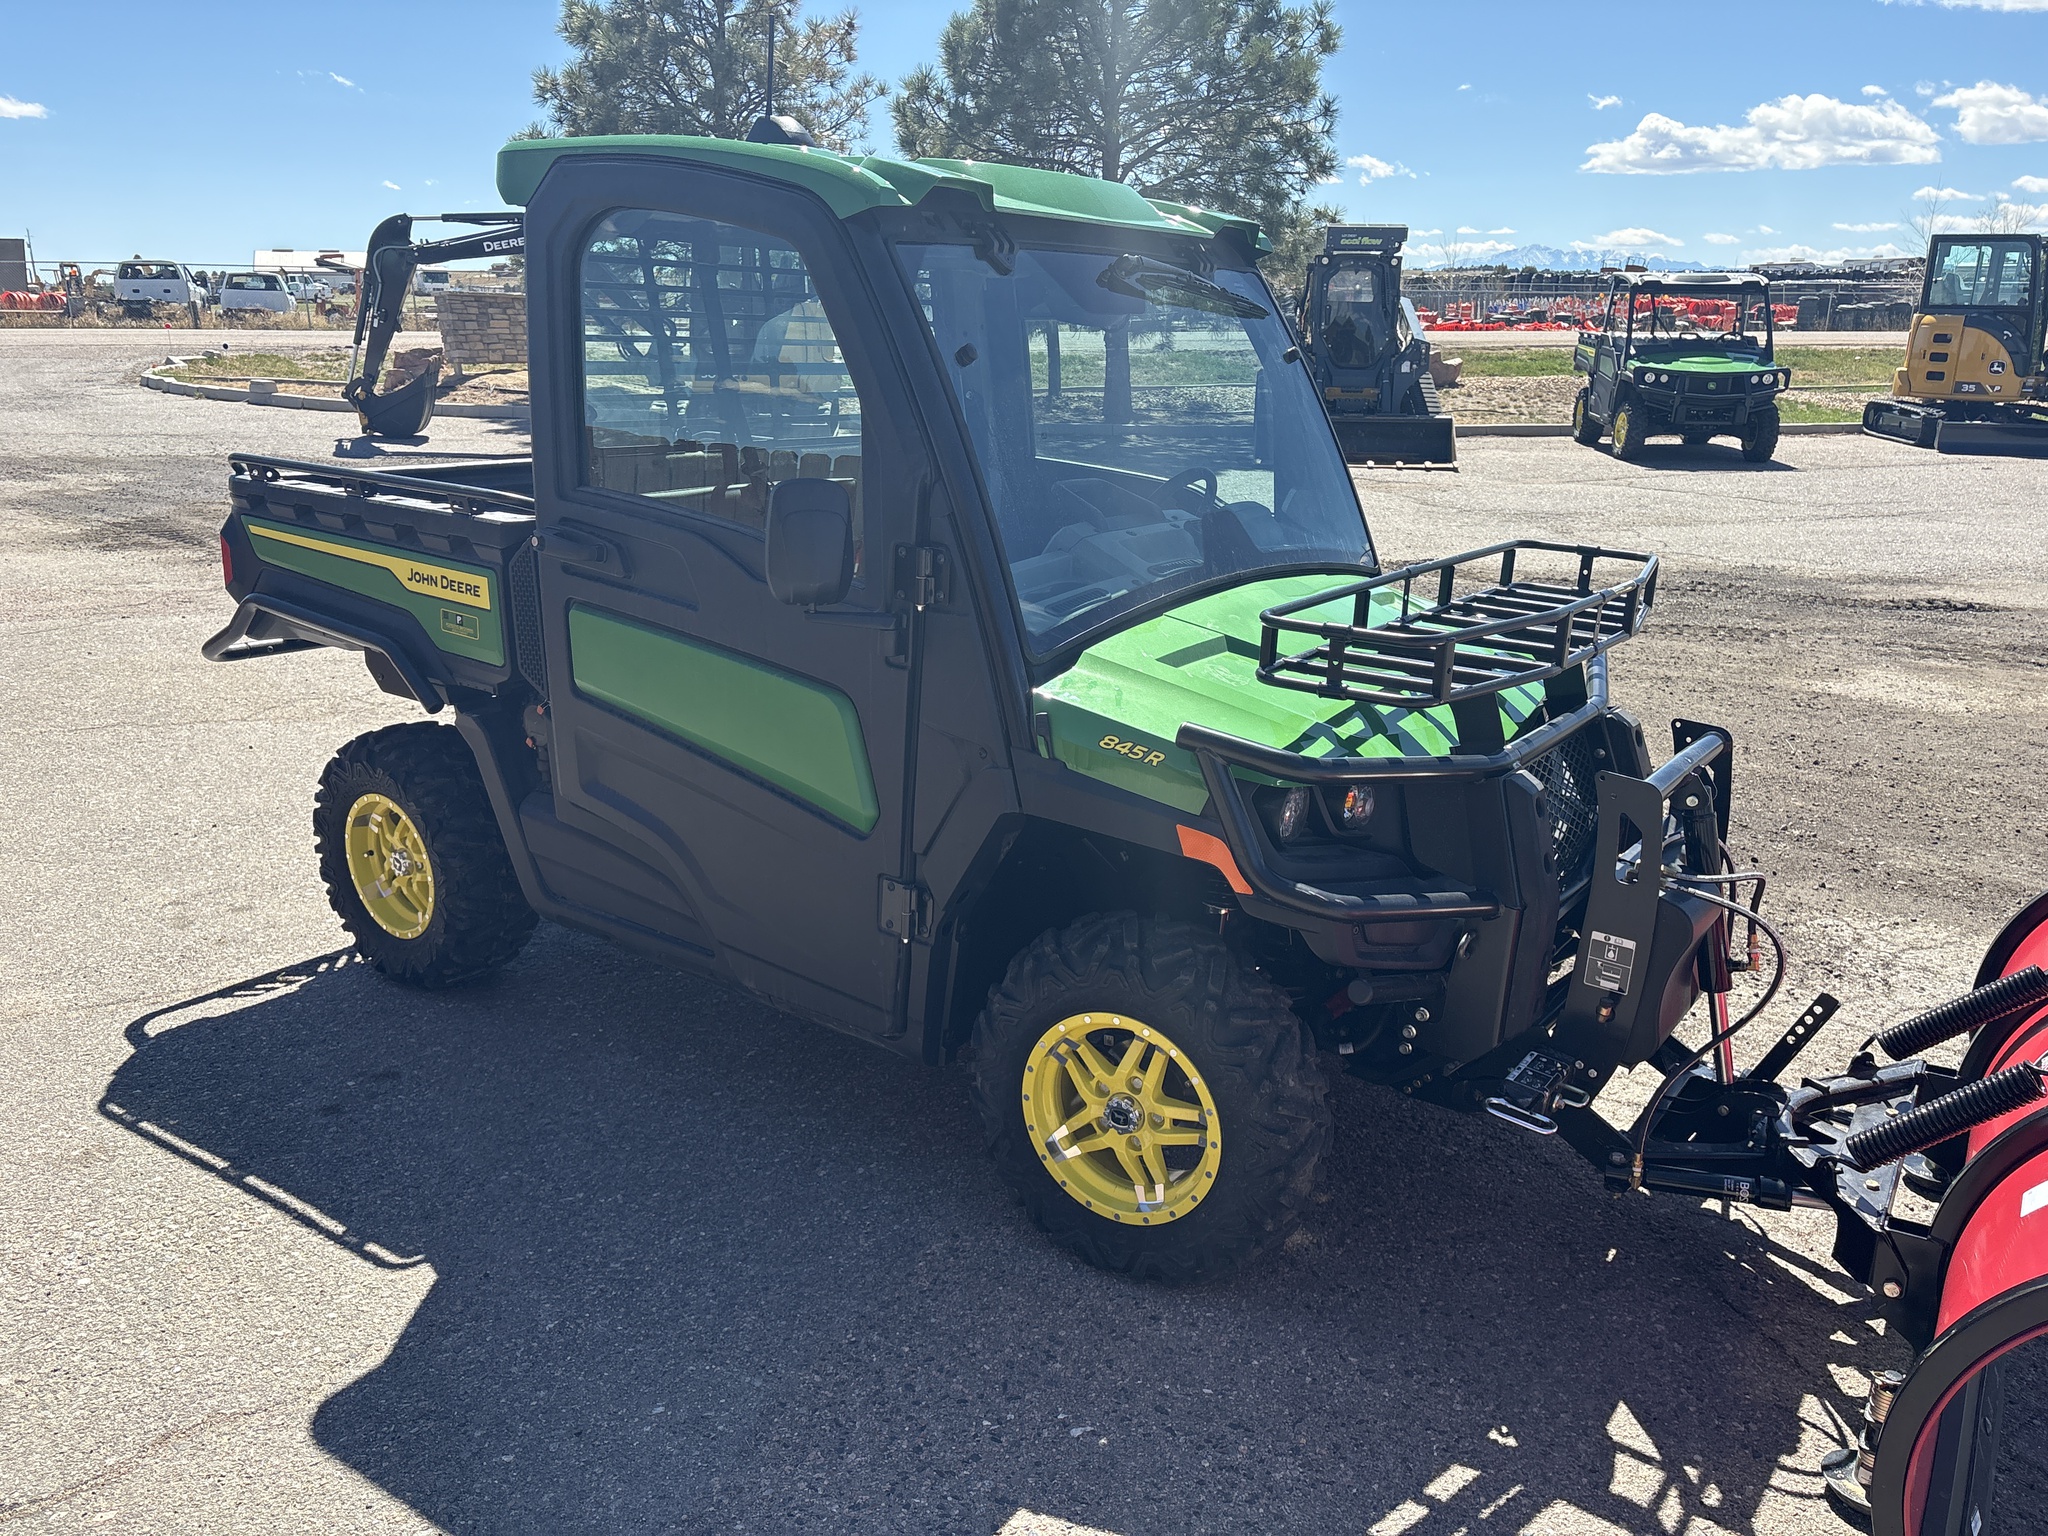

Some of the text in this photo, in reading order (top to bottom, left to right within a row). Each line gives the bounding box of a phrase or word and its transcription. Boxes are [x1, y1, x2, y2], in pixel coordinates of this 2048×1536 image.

[483, 237, 525, 252] DEERE
[1961, 384, 1976, 392] 35
[407, 568, 481, 598] JOHN DEERE
